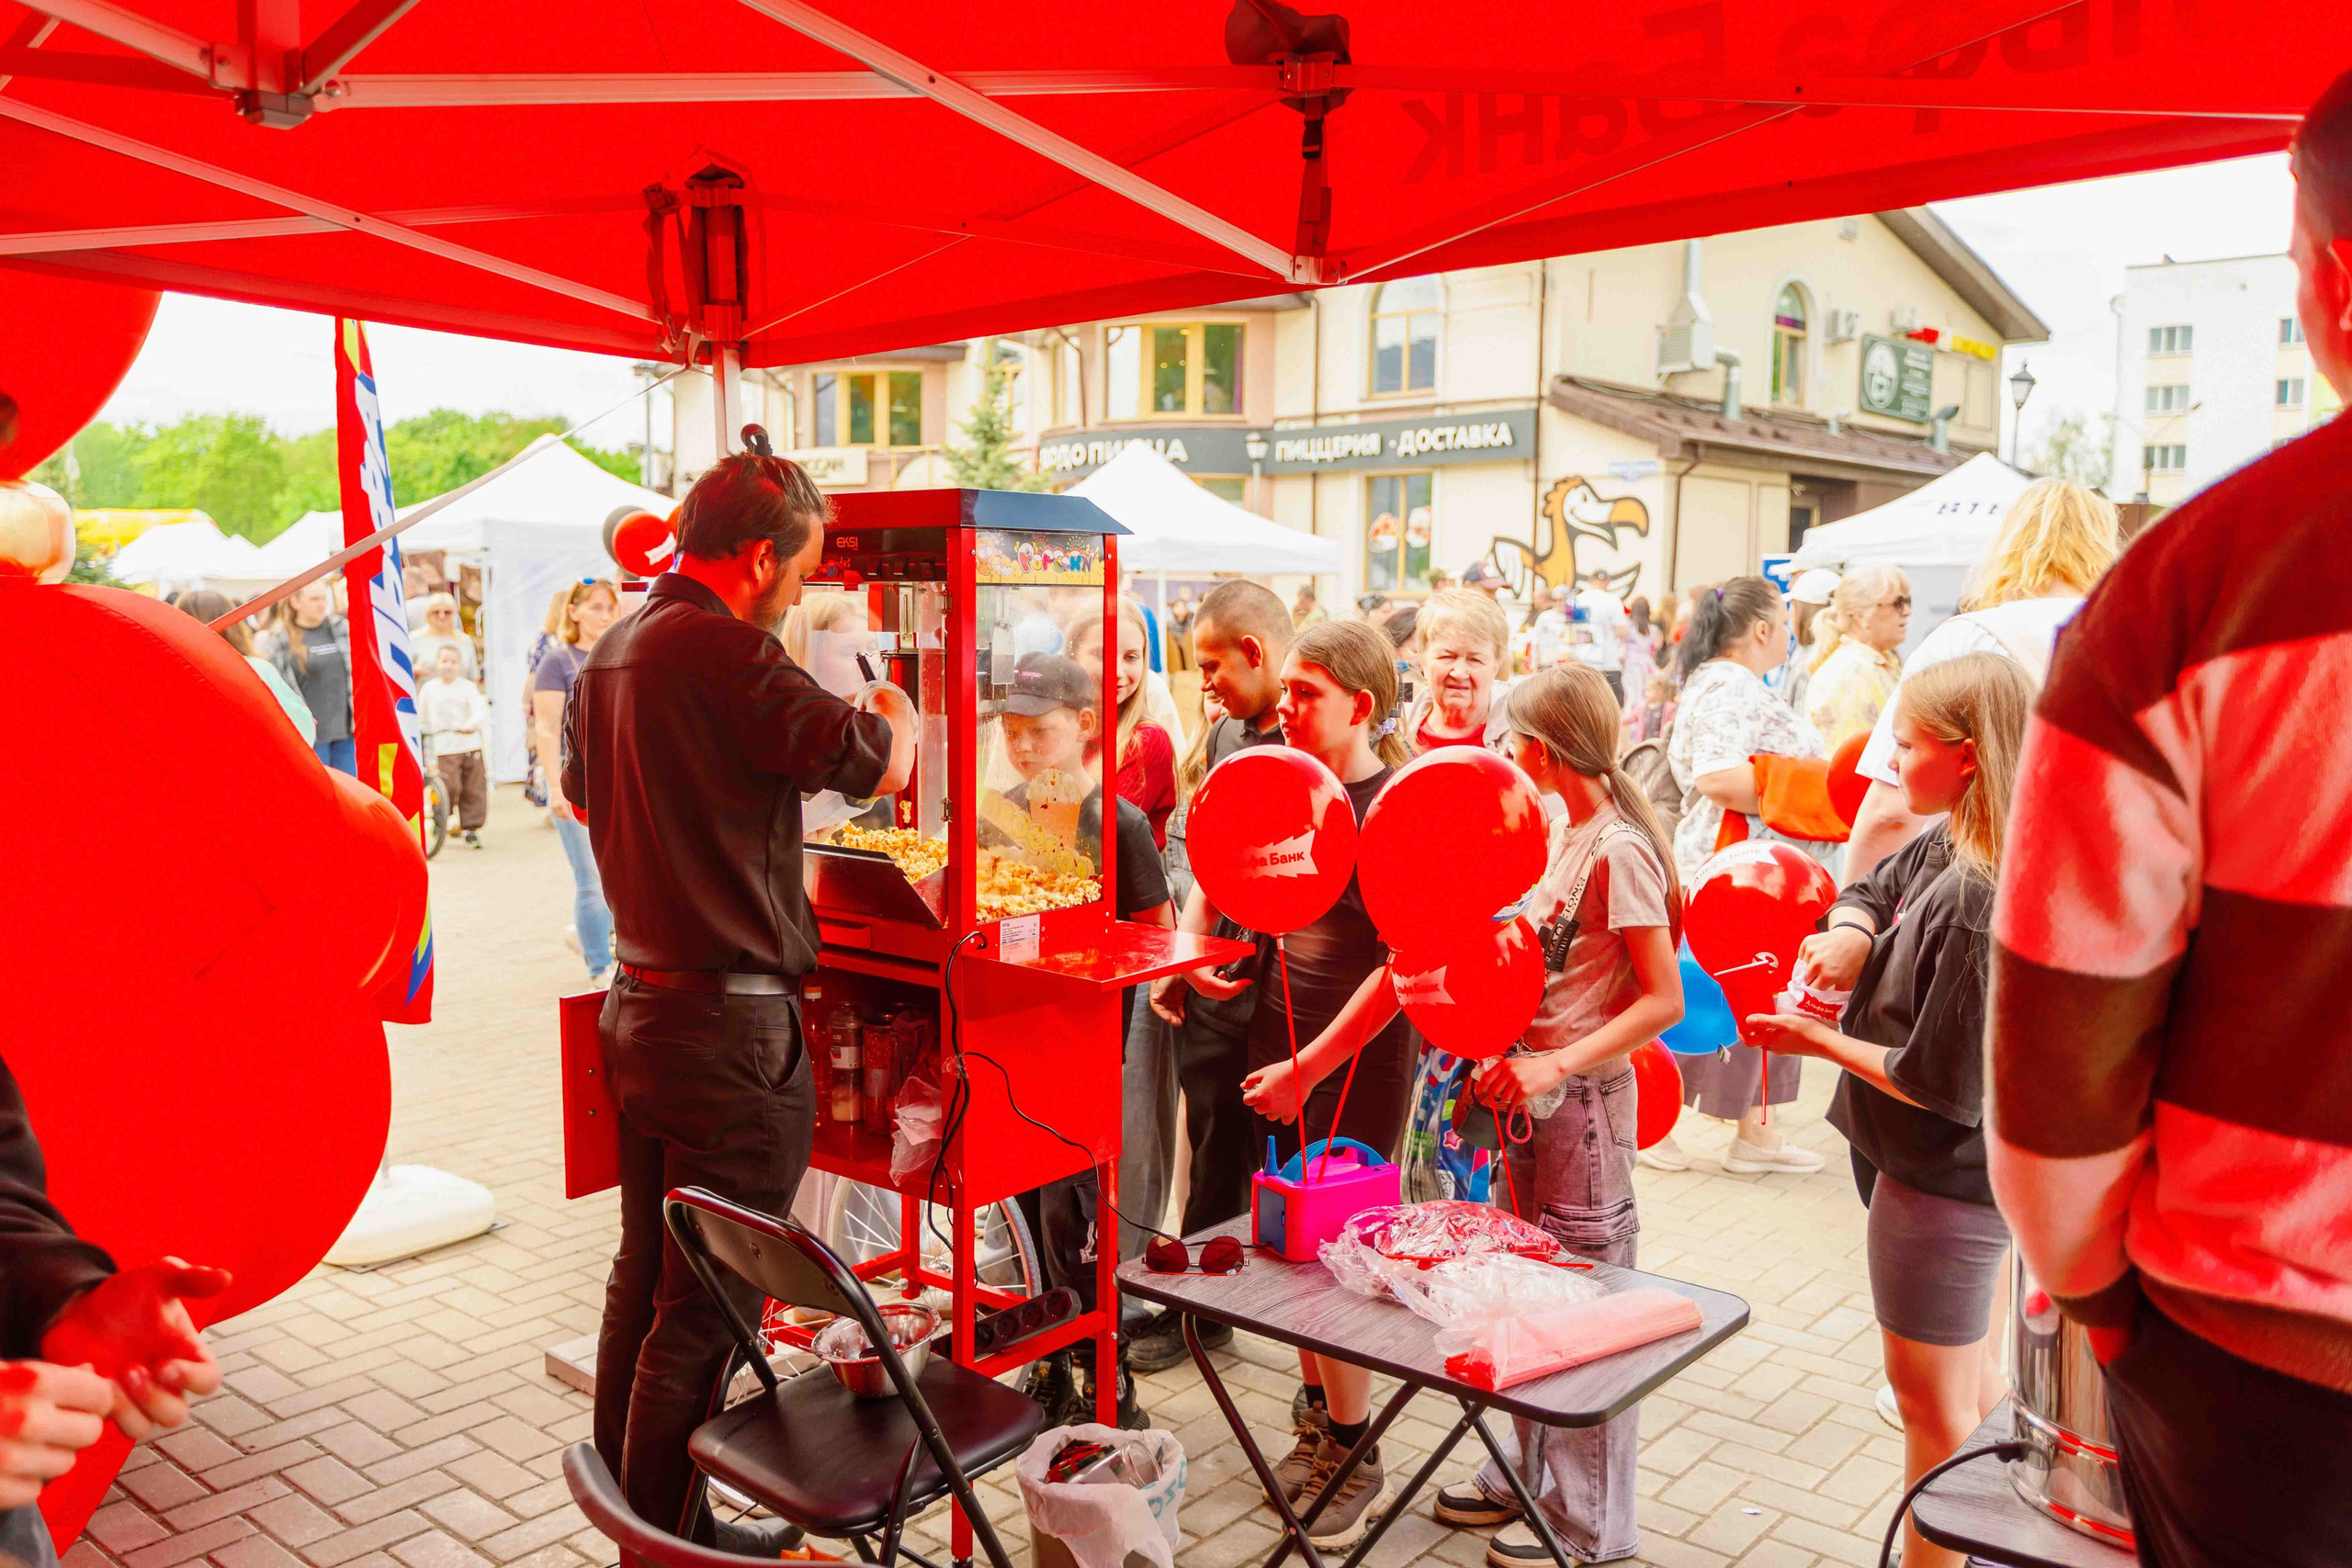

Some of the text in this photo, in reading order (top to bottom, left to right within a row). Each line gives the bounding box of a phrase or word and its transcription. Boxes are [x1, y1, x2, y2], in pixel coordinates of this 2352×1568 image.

[1275, 422, 1513, 463] ПИЦЦЕРИЯ ДОСТАВКА
[836, 536, 858, 548] EKSI
[1270, 851, 1306, 865] Банк
